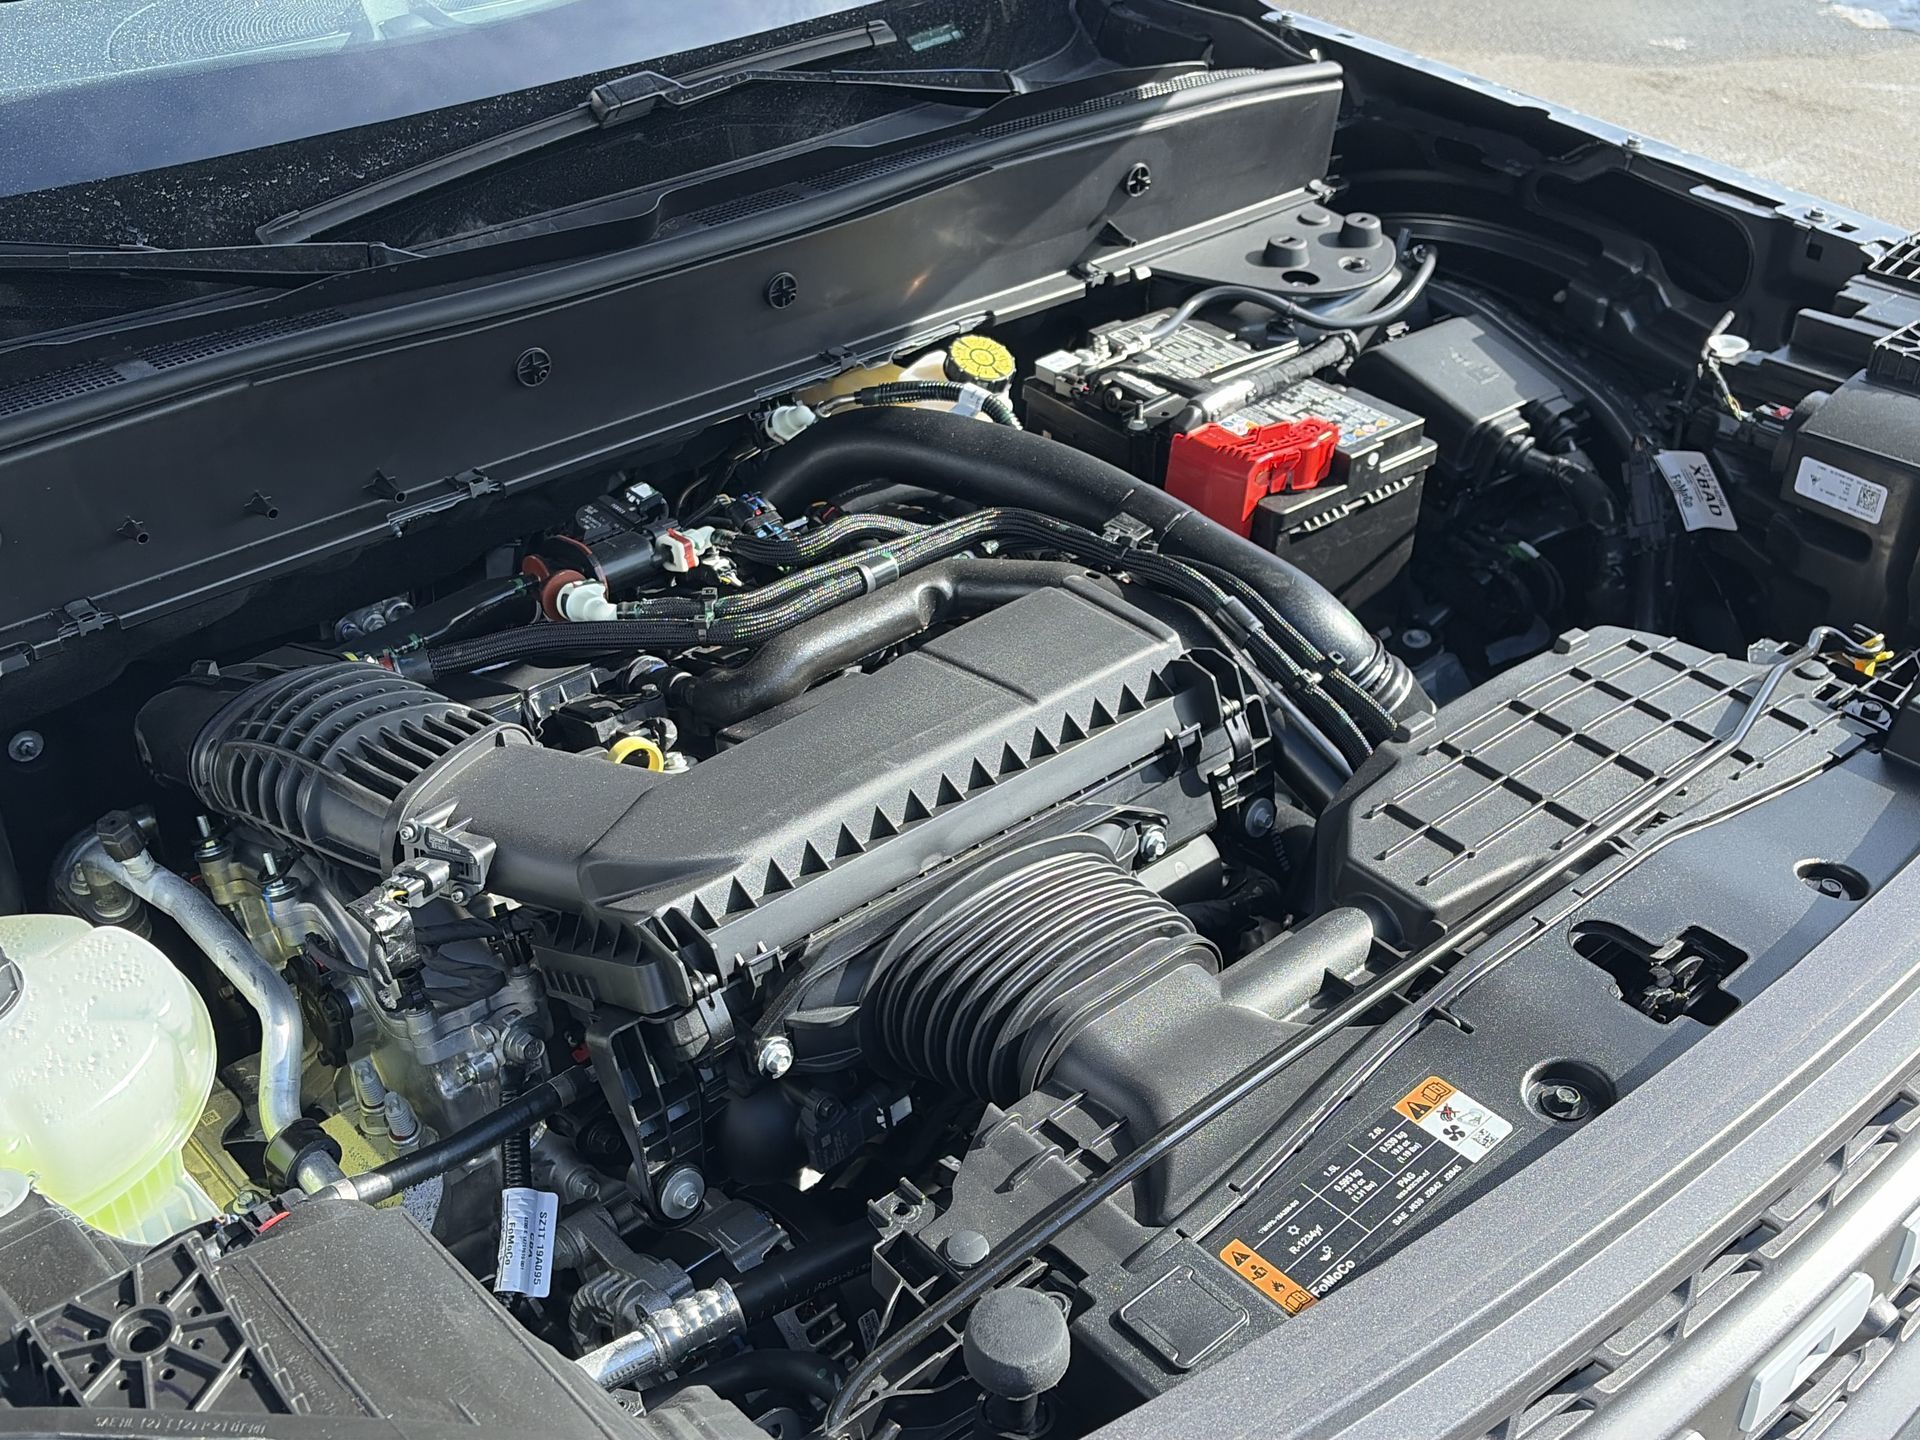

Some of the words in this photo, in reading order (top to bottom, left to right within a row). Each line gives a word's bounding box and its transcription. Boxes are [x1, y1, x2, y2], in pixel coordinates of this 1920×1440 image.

[1689, 464, 1722, 516] XBAD
[1368, 1126, 1386, 1140] 2.0L
[1395, 1131, 1408, 1141] kg
[1323, 1164, 1341, 1177] 1.5L
[1349, 1169, 1364, 1179] kg
[1396, 1171, 1416, 1188] PAG
[538, 1211, 547, 1240] SZ1T
[1392, 1211, 1409, 1226] SAE
[505, 1221, 515, 1265] FoMoCo
[1288, 1224, 1324, 1255] R-1234yf
[533, 1245, 544, 1285] 19A095
[1310, 1260, 1356, 1298] FoMoCo
